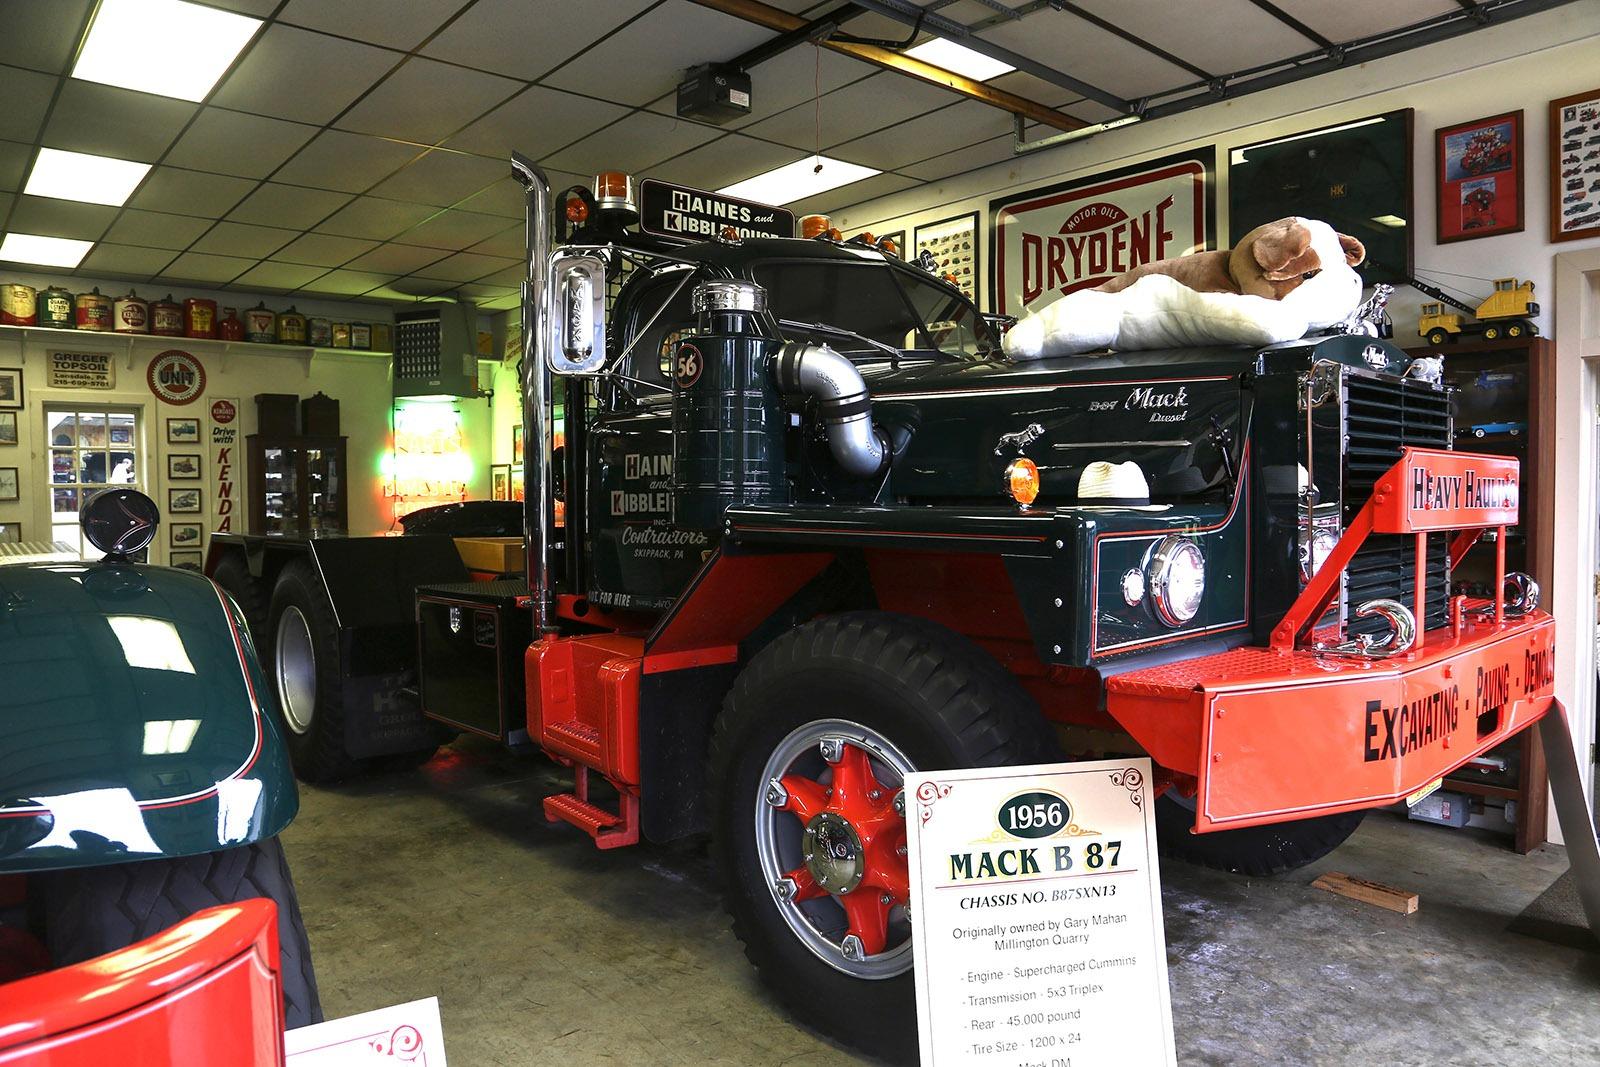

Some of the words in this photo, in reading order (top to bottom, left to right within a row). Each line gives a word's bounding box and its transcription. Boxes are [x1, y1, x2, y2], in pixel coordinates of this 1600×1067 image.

[672, 190, 751, 222] HAINES
[754, 213, 775, 223] and
[1067, 207, 1097, 230] MOTOR
[1100, 206, 1119, 219] OILS
[53, 353, 108, 363] GREGER
[53, 361, 108, 371] TOPSOIL
[677, 352, 697, 377] 56
[160, 371, 194, 385] UNIT
[1123, 386, 1188, 410] Mack
[1149, 410, 1187, 422] Diesel
[212, 427, 236, 437] Drive
[213, 435, 234, 444] with
[650, 477, 674, 489] and
[622, 526, 708, 545] Contractors
[674, 550, 684, 559] PA
[600, 592, 612, 605] FOR
[614, 593, 631, 607] HIRE
[1008, 803, 1063, 830] 1956
[951, 847, 1041, 880] MACK
[1054, 846, 1073, 871] B
[1086, 840, 1122, 869] 87
[960, 894, 1017, 910] CHASSIS
[1022, 891, 1047, 904] NO.
[1052, 885, 1116, 902] B87SXN13
[953, 925, 1006, 940] Originally
[1010, 921, 1045, 934] owned
[1048, 920, 1060, 932] by
[1064, 917, 1089, 930] Gary
[1092, 913, 1127, 926] Mahan
[995, 936, 1049, 951] Millington
[1052, 934, 1089, 946] Quarry
[968, 970, 1003, 984] Engine
[1014, 961, 1085, 979] Supercharged
[1089, 956, 1136, 970] Cummins
[968, 990, 1037, 1006] Transmission
[1047, 986, 1066, 998] 5x3
[1069, 983, 1104, 997] Triplex
[971, 1019, 996, 1031] Rear
[1047, 1009, 1081, 1024] pound
[972, 1044, 993, 1055] Tire
[996, 1041, 1018, 1053] Size
[1030, 1036, 1055, 1048] 1200
[1068, 1033, 1081, 1044] 24
